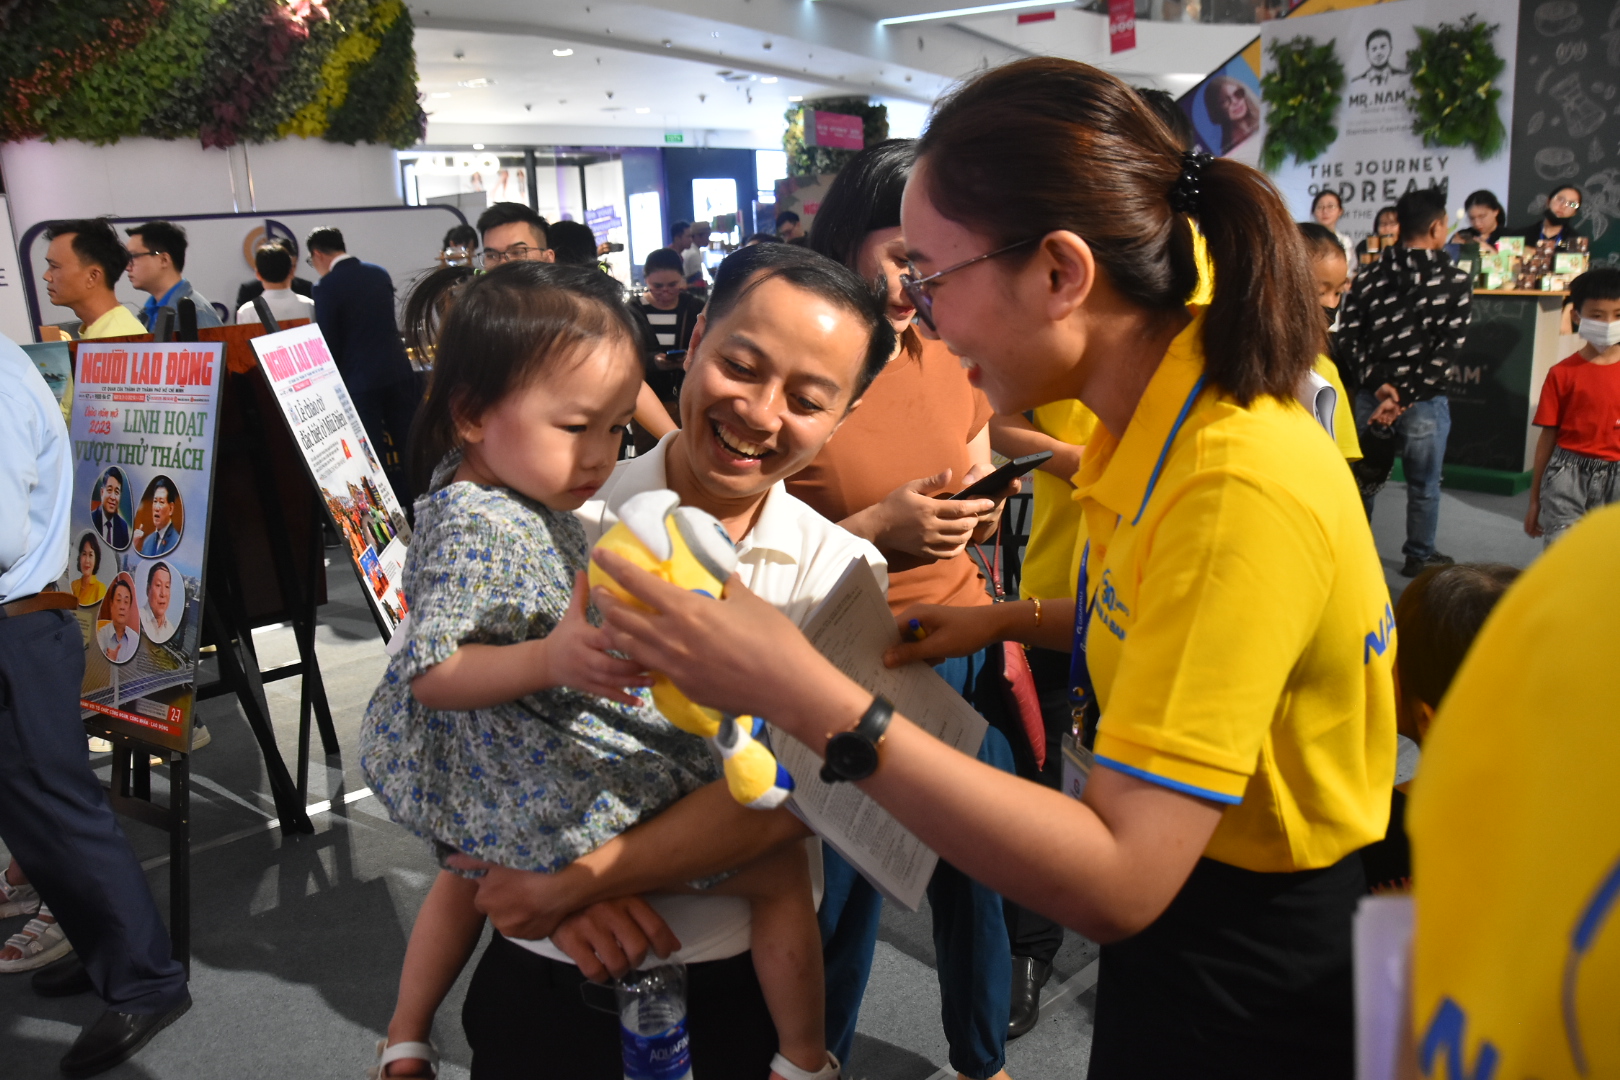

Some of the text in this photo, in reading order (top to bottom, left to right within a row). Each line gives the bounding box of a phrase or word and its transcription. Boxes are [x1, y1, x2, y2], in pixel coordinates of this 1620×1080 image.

[1308, 156, 1449, 179] THE JOURNEY
[81, 348, 214, 388] NGƯỜI LAO ĐỘNG
[89, 420, 111, 435] 2023
[123, 409, 208, 443] LINH HOẠT
[75, 438, 205, 471] VƯỢT THỬ THÁCH
